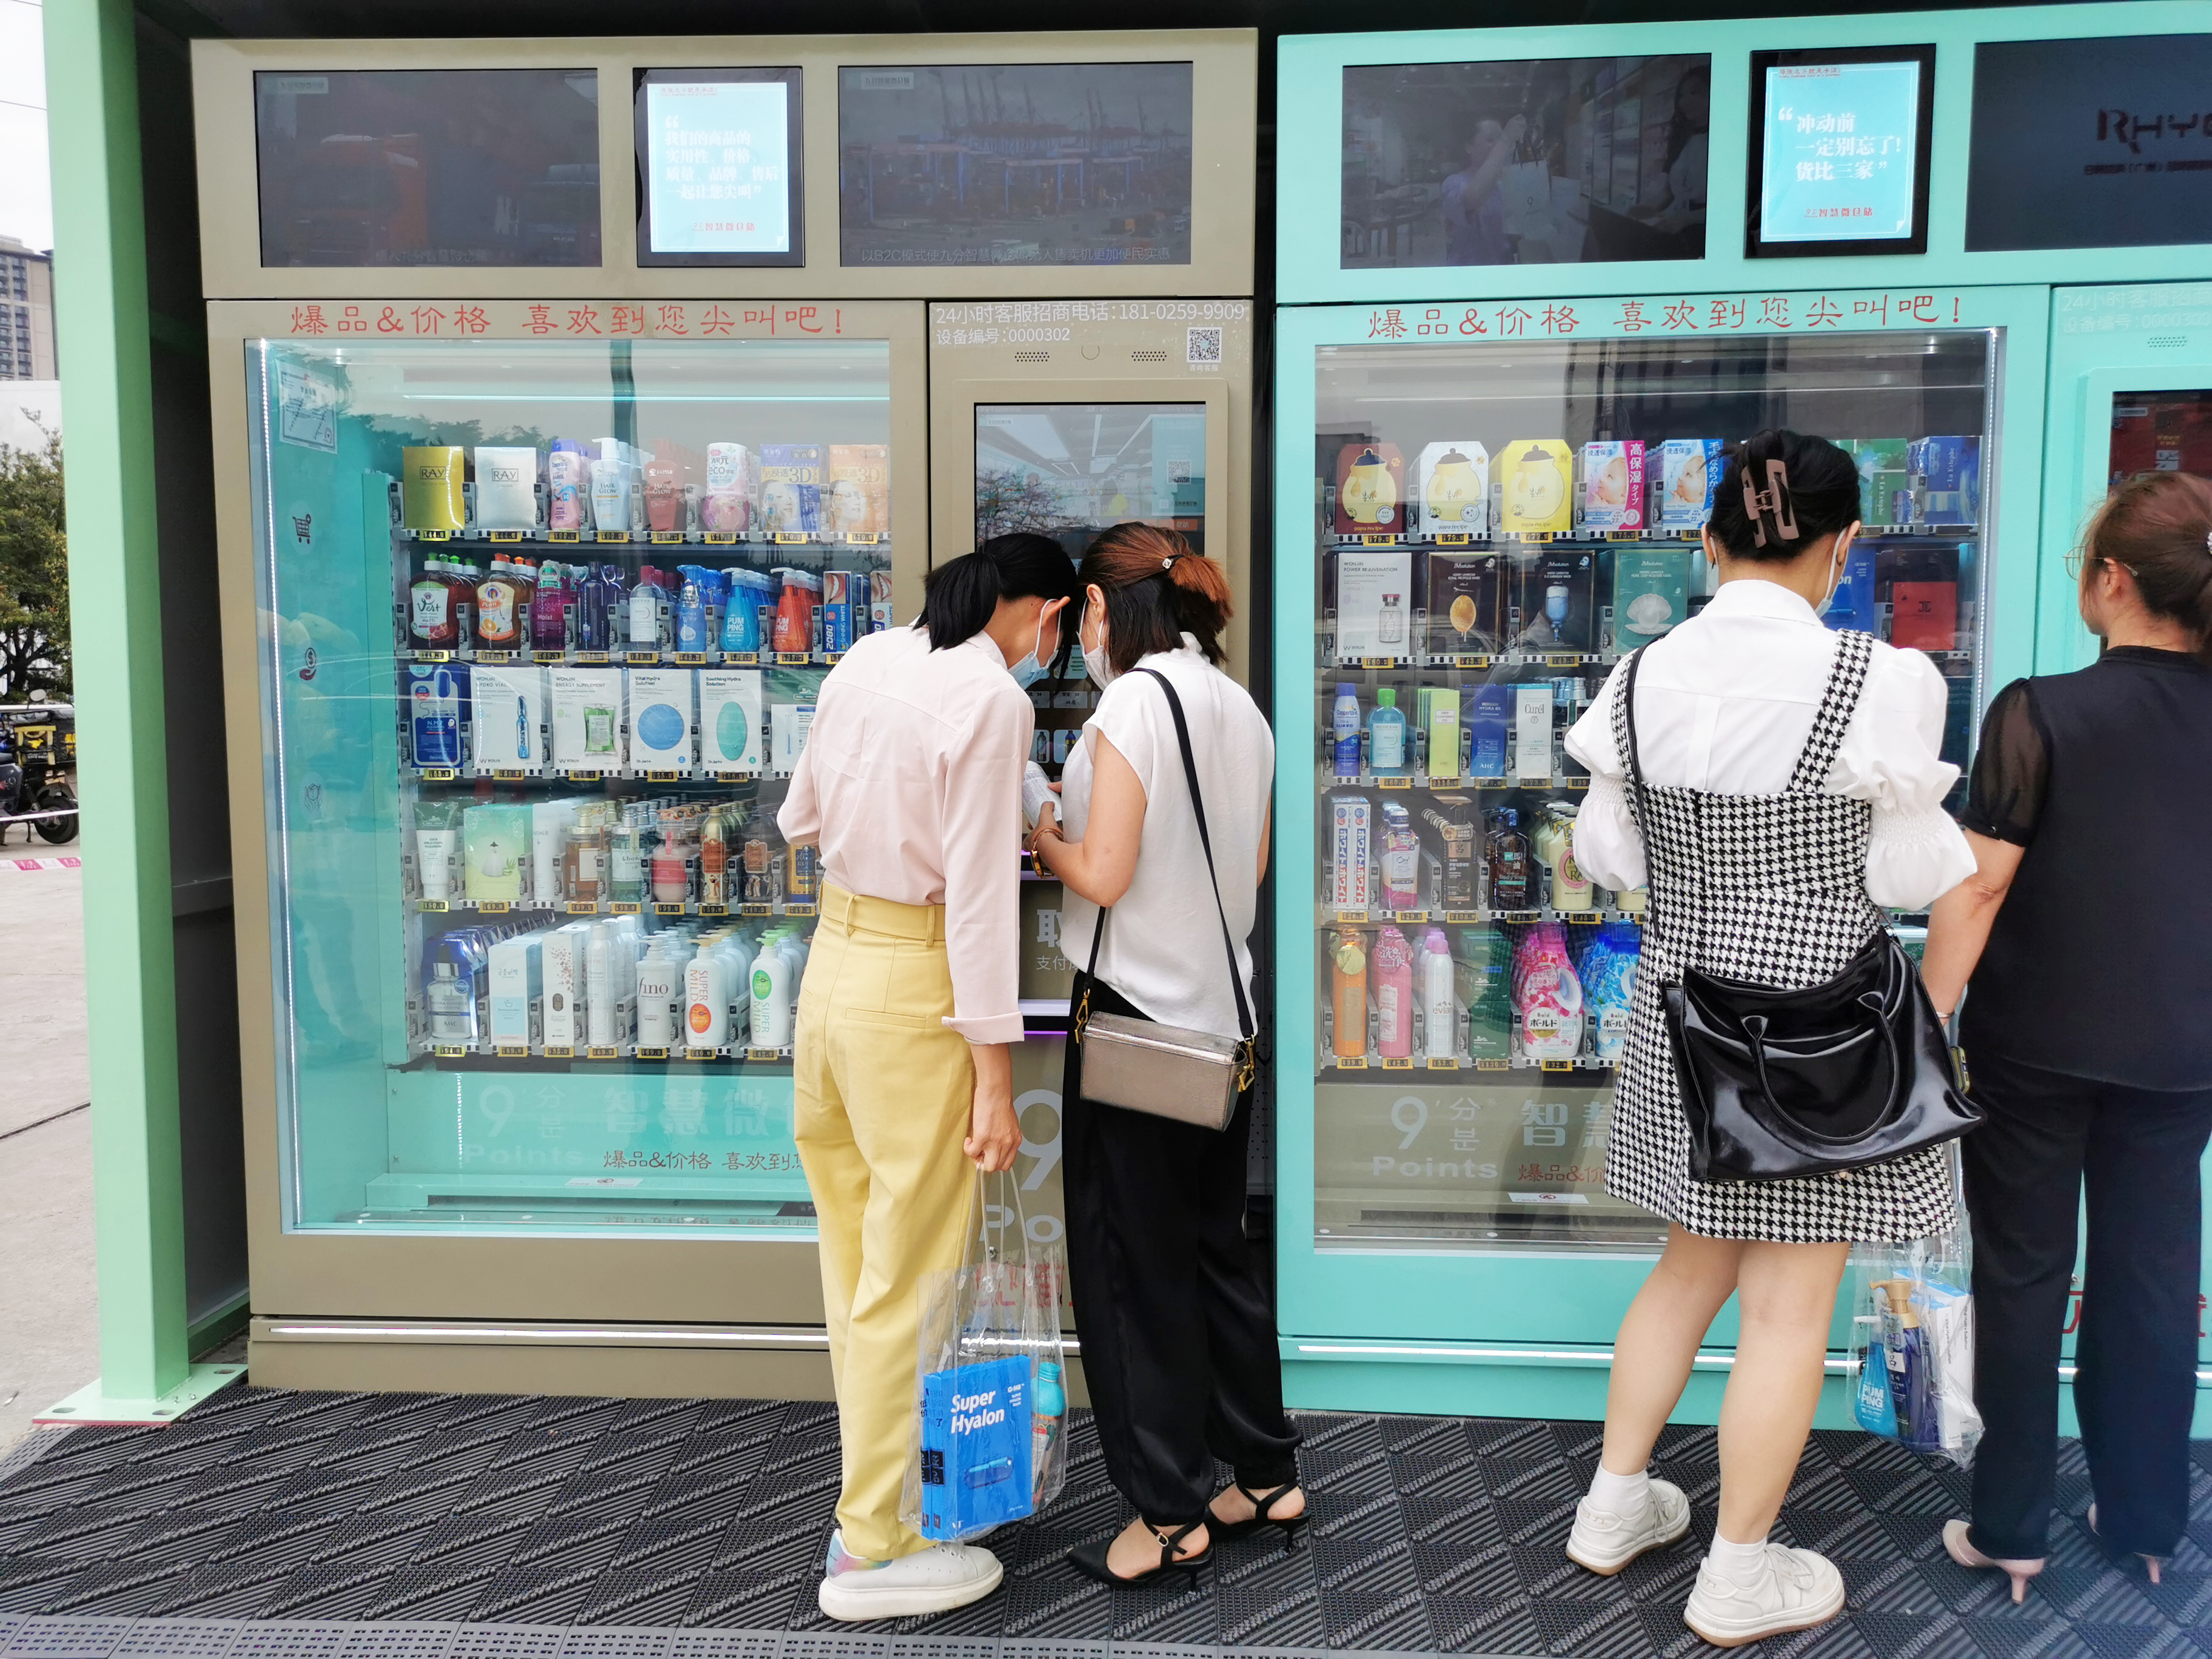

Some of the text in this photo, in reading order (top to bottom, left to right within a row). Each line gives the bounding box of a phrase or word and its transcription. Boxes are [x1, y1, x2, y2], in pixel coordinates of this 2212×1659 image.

[1795, 135, 1901, 157] 一定别忘了!
[291, 304, 842, 336] 爆品&价格 喜欢到您尖叫吧!
[936, 303, 1245, 325] 24小时客服招商电话:181-0259-9909
[1369, 295, 1960, 339] 爆品&价格 喜欢到您尖叫吧!
[936, 327, 1070, 346] 设备编号:0000302
[421, 468, 445, 478] RAY
[493, 471, 517, 480] RAY
[789, 468, 811, 483] 3D
[858, 468, 880, 483] 3D
[1629, 443, 1643, 506] 高保湿タイプ
[417, 598, 442, 612] Vert
[1524, 703, 1544, 714] Curél
[638, 977, 669, 997] fino
[689, 969, 699, 1002] MILD
[699, 970, 708, 1001] SUPER
[761, 1002, 770, 1033] SUPER
[1013, 1089, 1062, 1190] 9
[603, 1150, 712, 1170] 爆品&价格
[1373, 1156, 1498, 1178] Points
[1518, 1164, 1606, 1183] 爆品&价
[950, 1390, 996, 1413] Super
[1862, 1395, 1883, 1408] PING
[1863, 1385, 1884, 1399] PUM
[951, 1407, 1005, 1436] Hyalon
